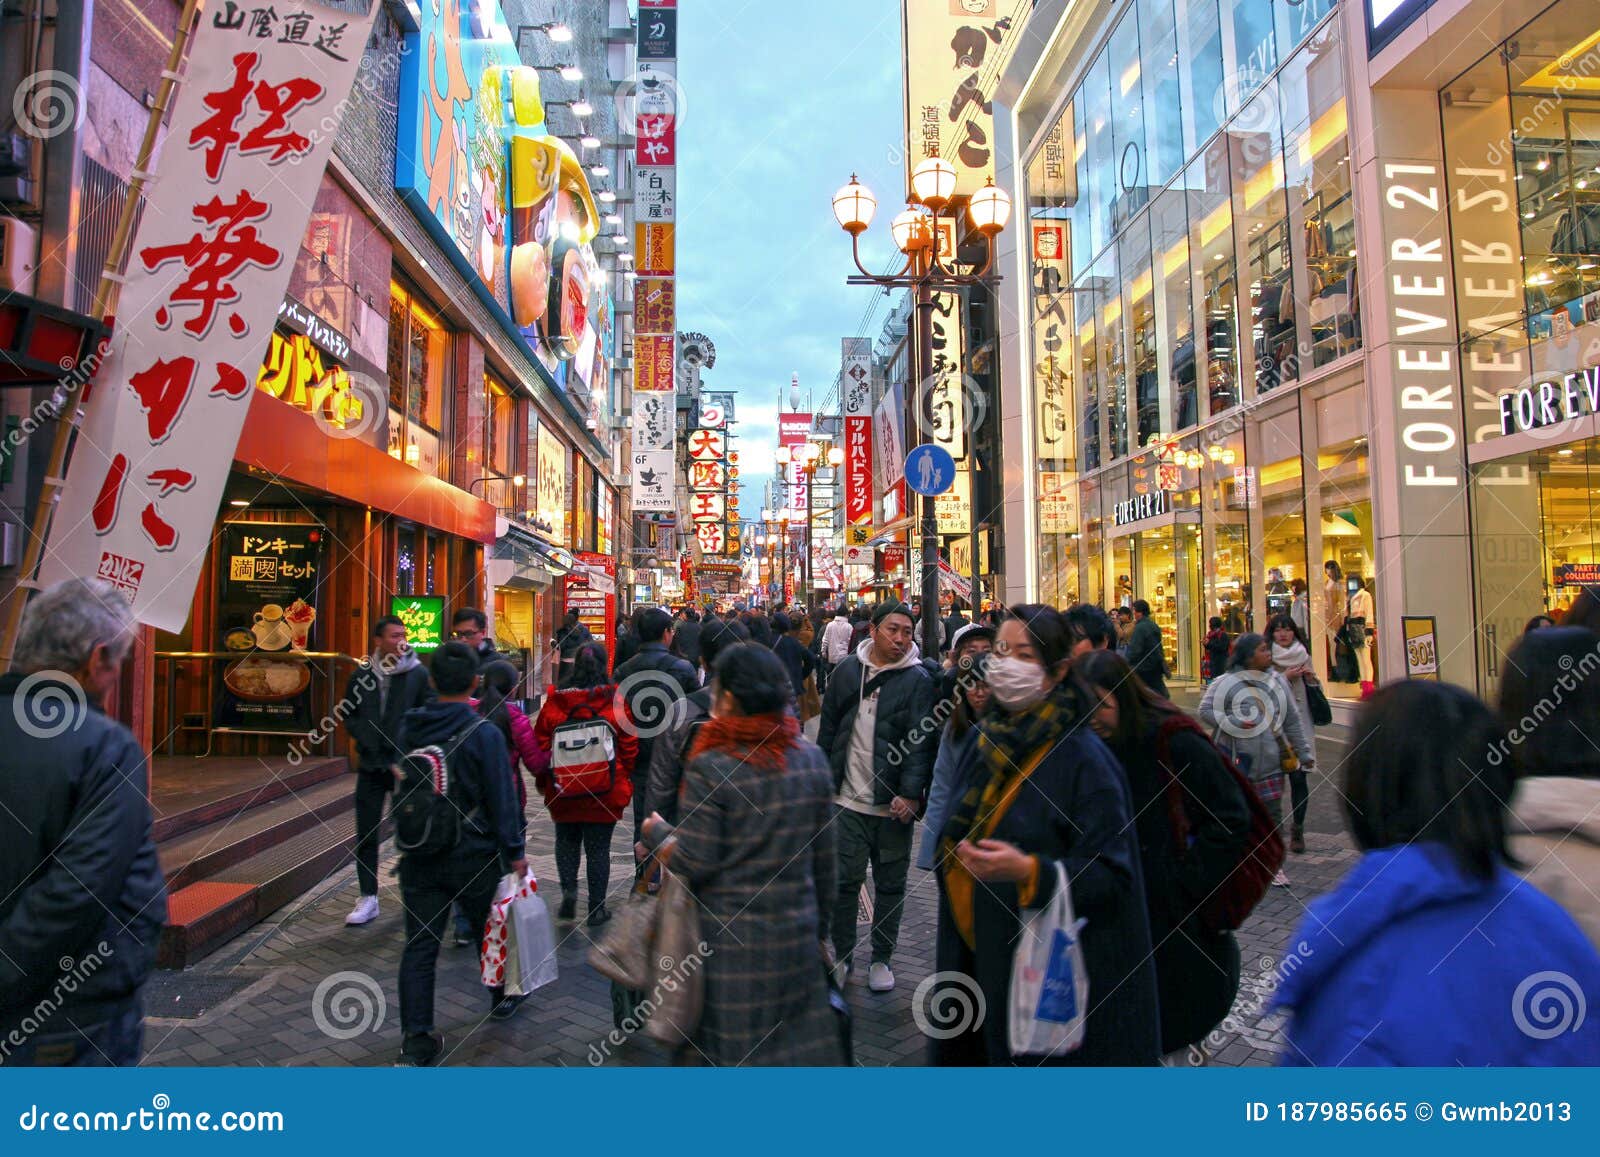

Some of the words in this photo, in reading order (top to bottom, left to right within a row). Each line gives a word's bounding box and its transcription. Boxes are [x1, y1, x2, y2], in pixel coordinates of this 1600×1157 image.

[213, 2, 349, 62] 山陰直送
[648, 173, 672, 217] 白木屋
[1384, 164, 1439, 211] 21
[92, 52, 325, 550] 松葉かに
[1391, 237, 1458, 487] FOREVER
[635, 455, 647, 464] 6F
[850, 419, 866, 512] ツルハドラッグ
[688, 430, 723, 552] 大阪王将
[1114, 495, 1151, 526] FOREVER
[1155, 489, 1165, 514] 21
[243, 536, 305, 554] ドンキー
[230, 556, 316, 582] 満喫セット
[1574, 564, 1599, 572] PARTY
